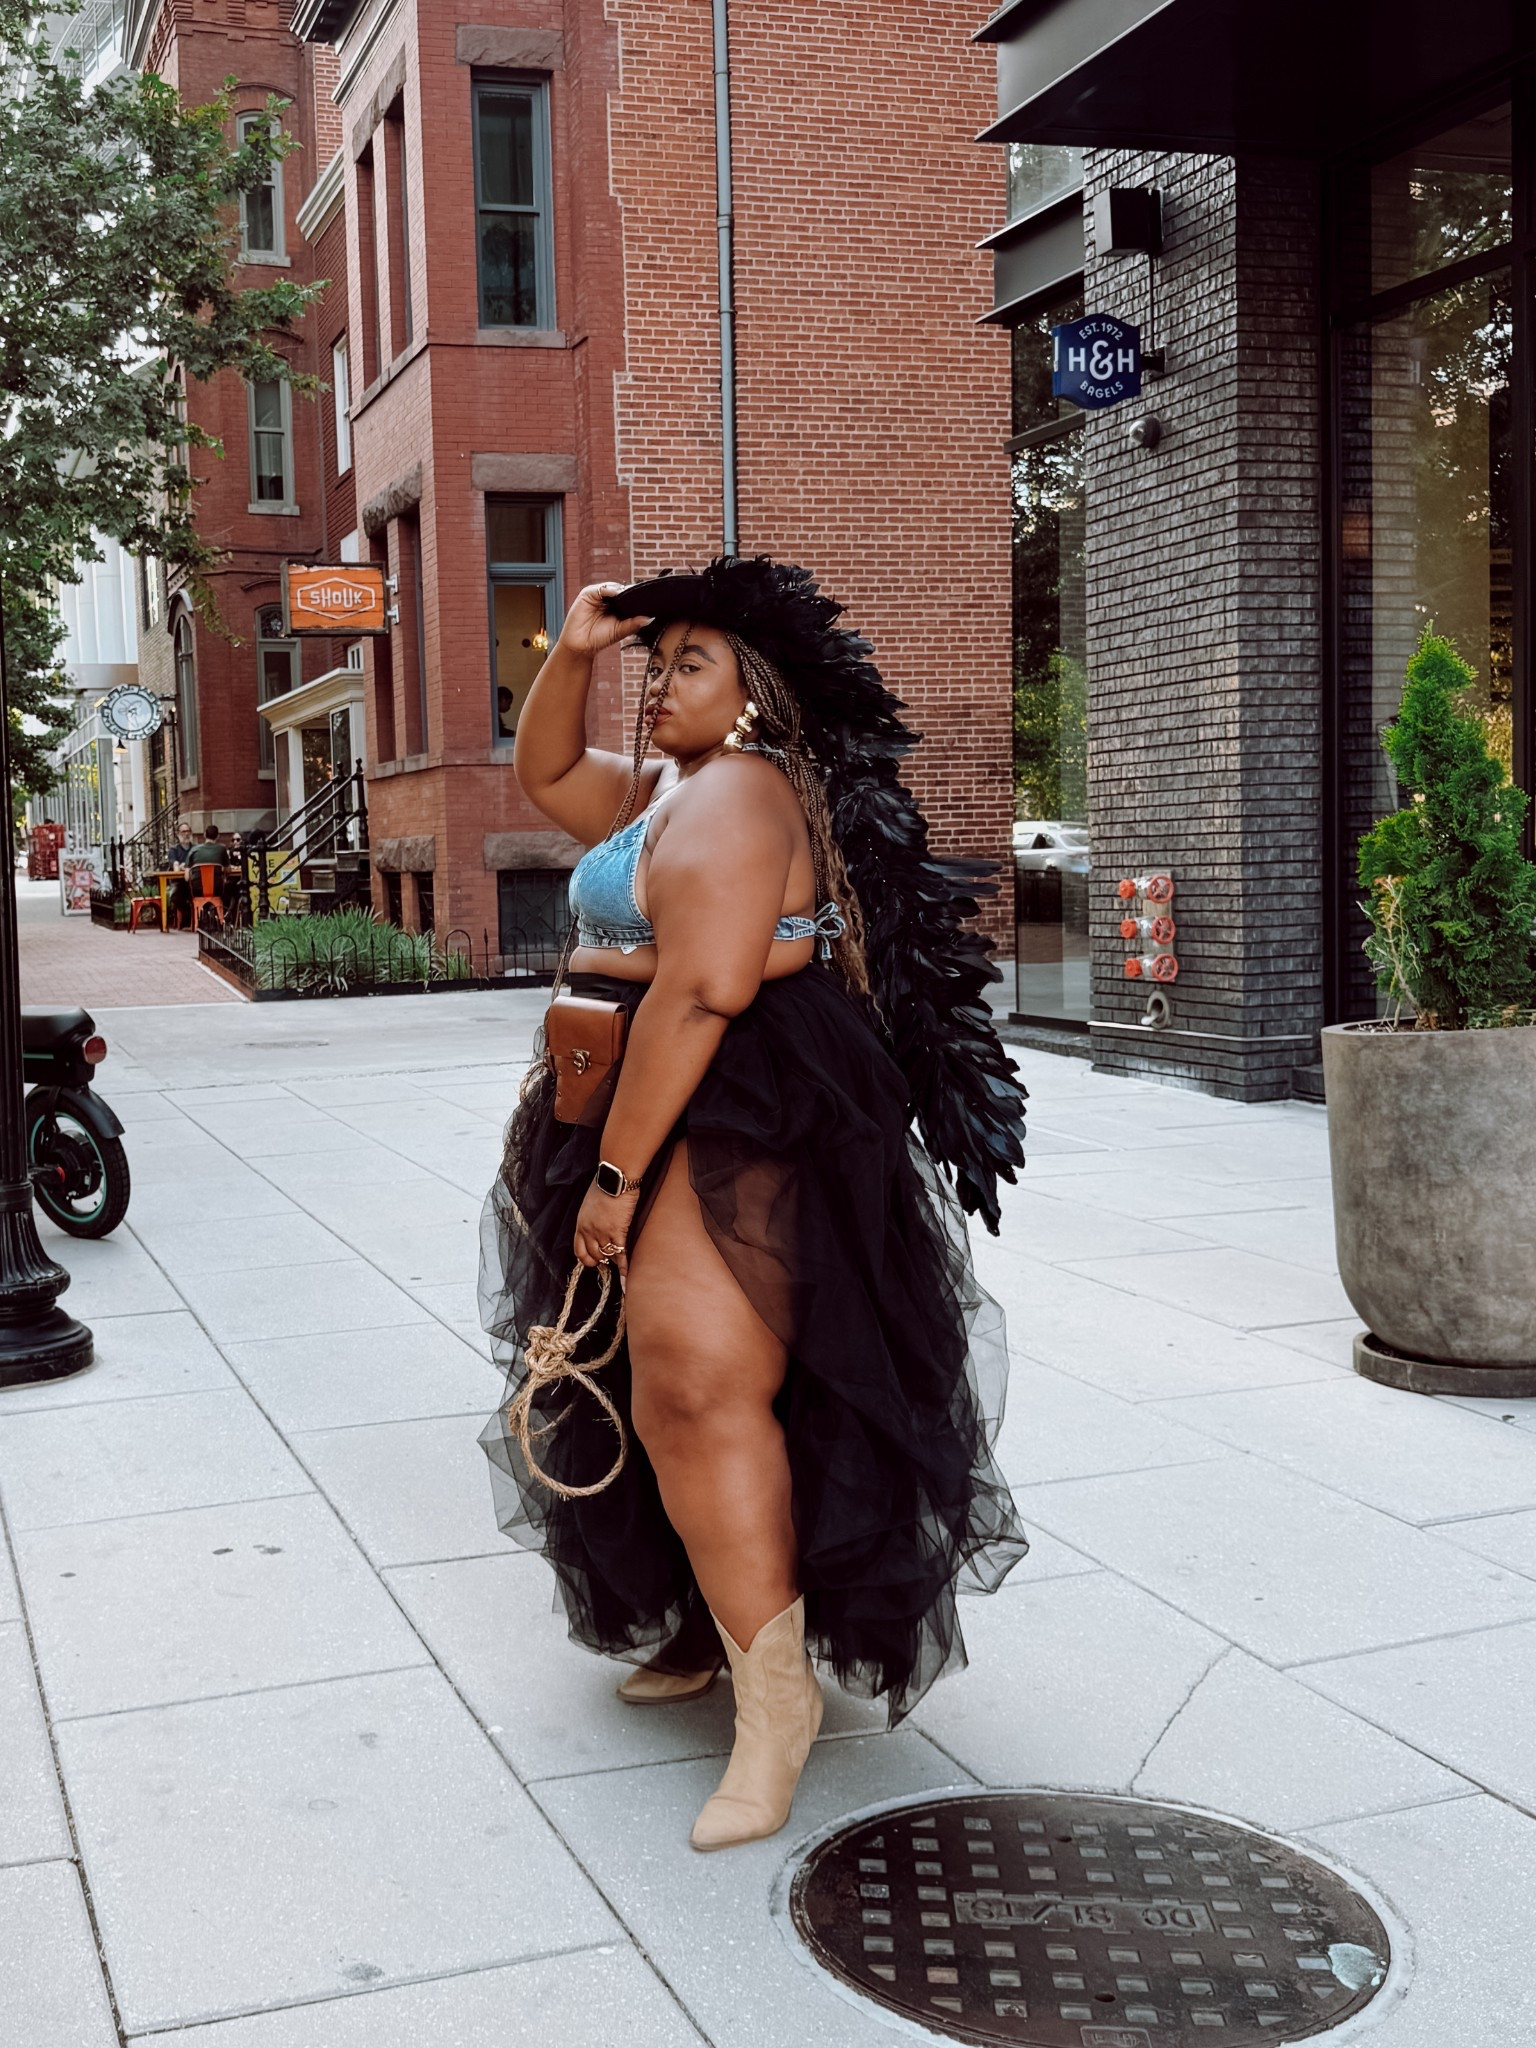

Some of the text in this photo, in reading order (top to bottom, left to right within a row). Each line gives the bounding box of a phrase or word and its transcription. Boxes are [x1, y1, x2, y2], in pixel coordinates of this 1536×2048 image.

[1079, 322, 1124, 341] EST. 1972
[1080, 380, 1124, 399] BAGELS
[310, 587, 363, 608] SHOUK
[1141, 1906, 1197, 1930] DC
